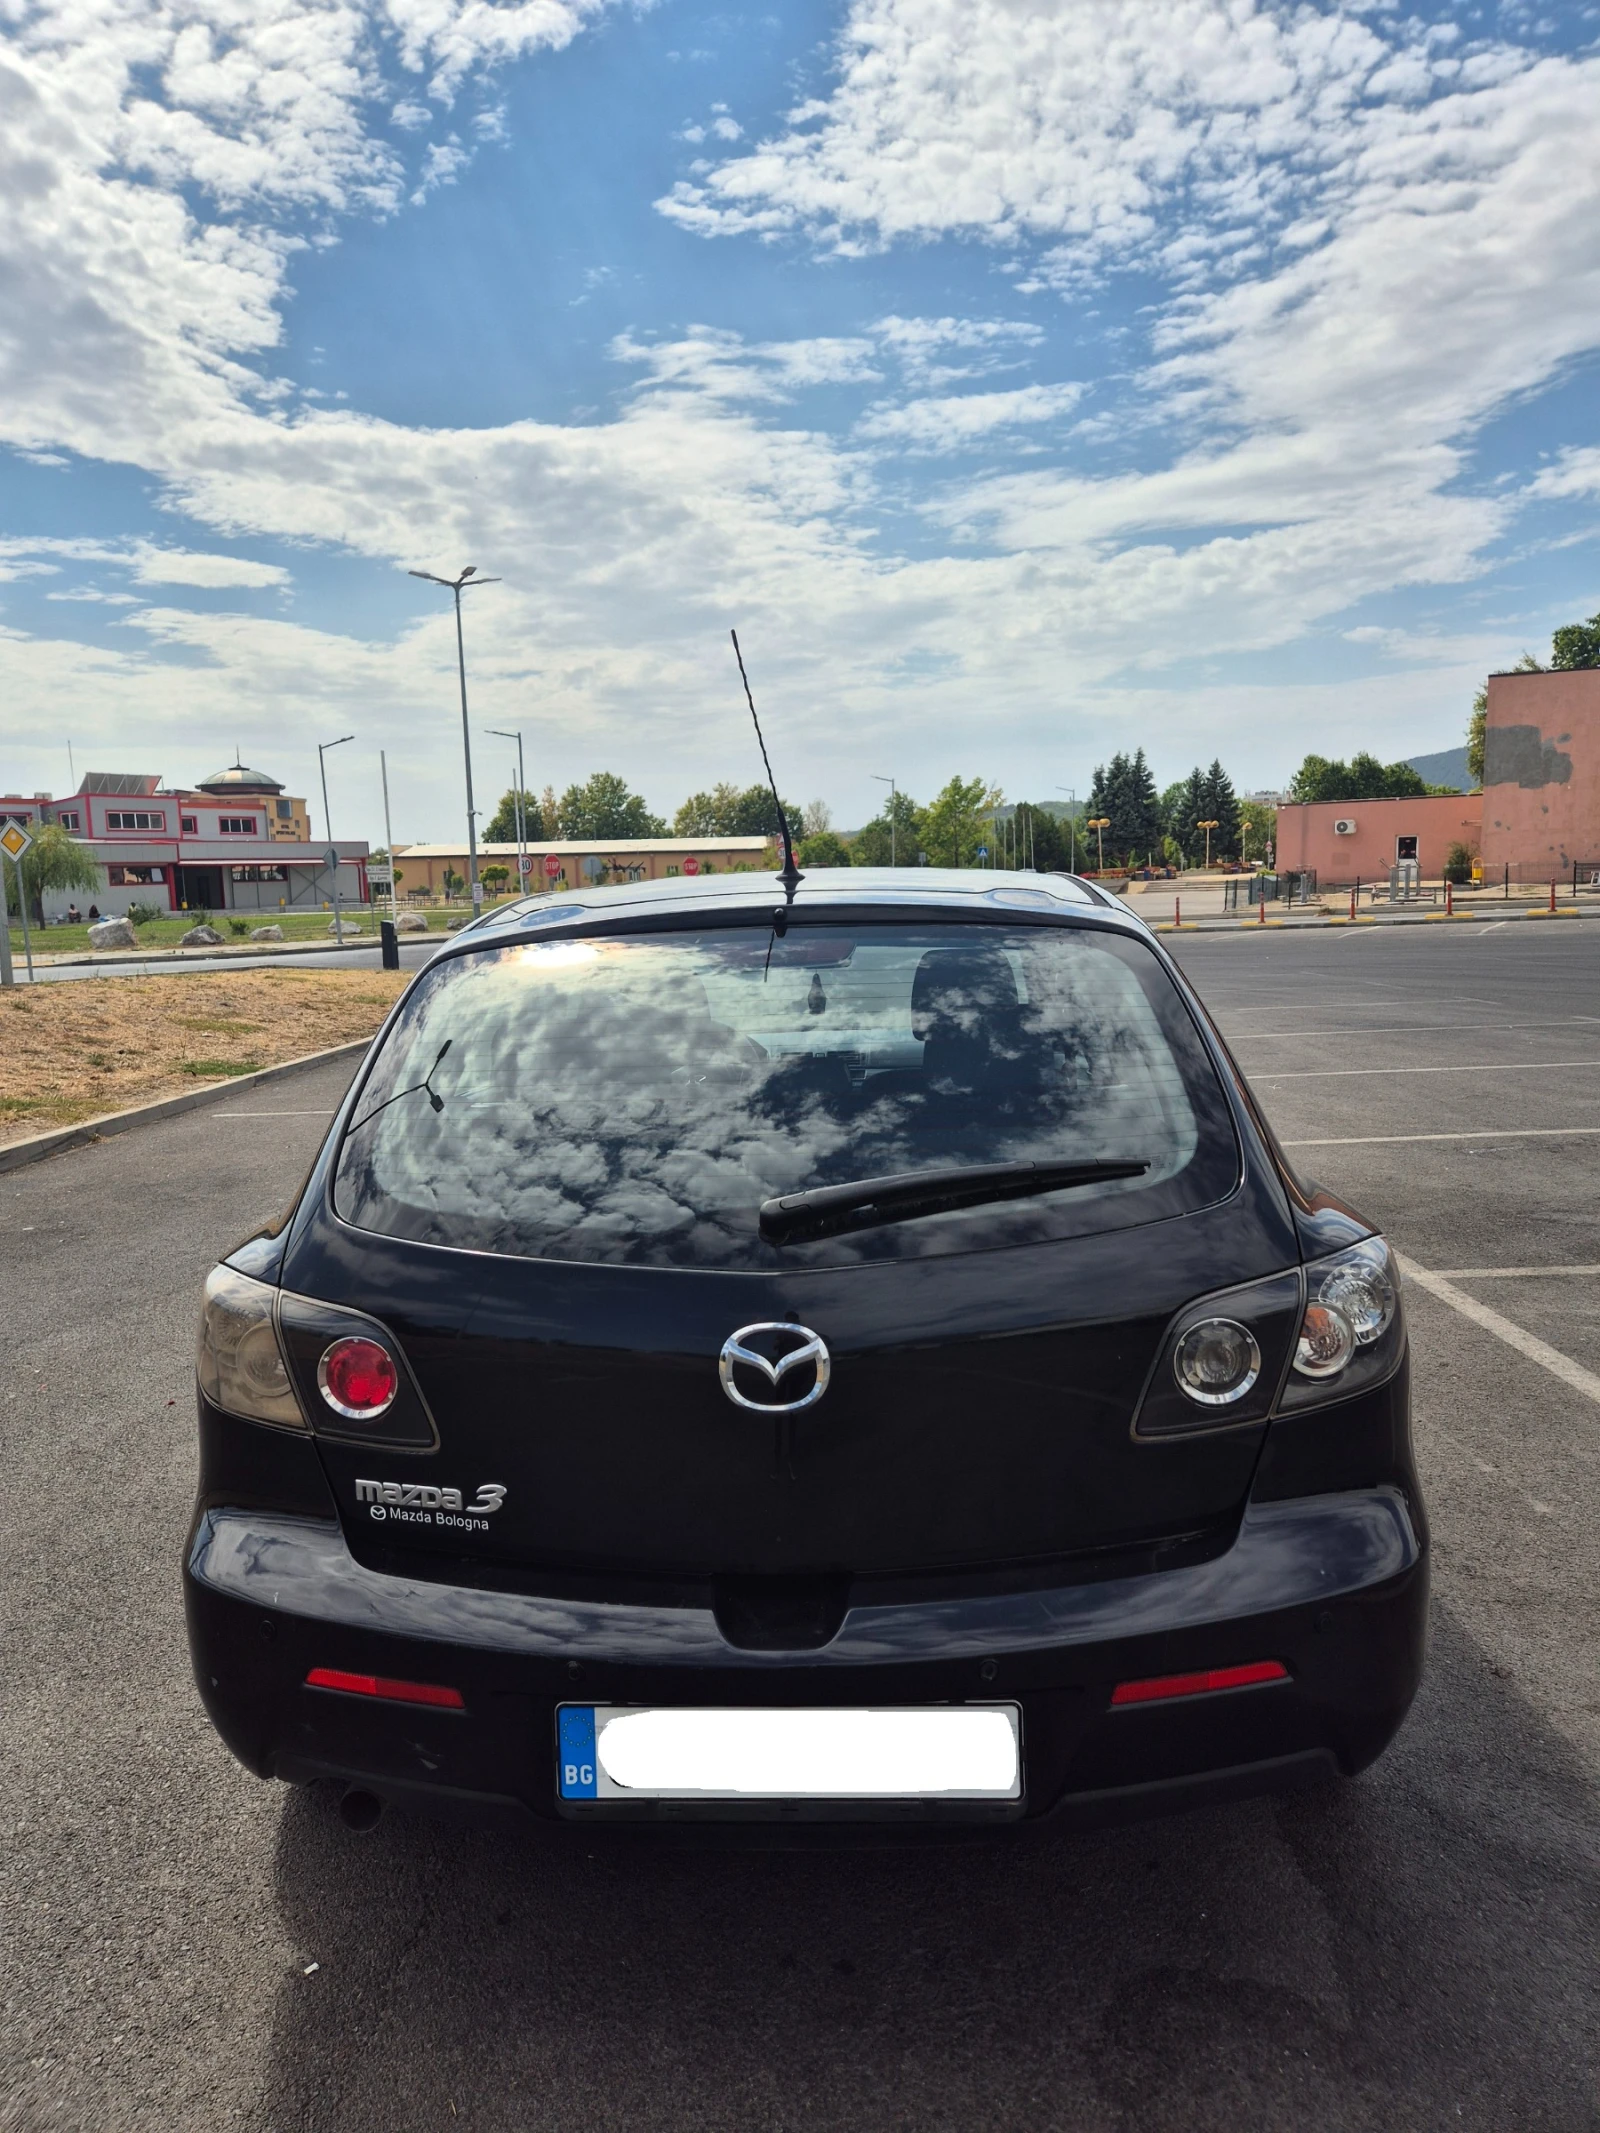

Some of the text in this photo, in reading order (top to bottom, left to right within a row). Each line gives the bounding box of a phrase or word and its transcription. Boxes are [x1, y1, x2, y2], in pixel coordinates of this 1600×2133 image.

[545, 861, 559, 870] STOP
[465, 1484, 507, 1513] 3
[390, 1507, 489, 1531] Mazda Bologna
[564, 1765, 593, 1785] BG
